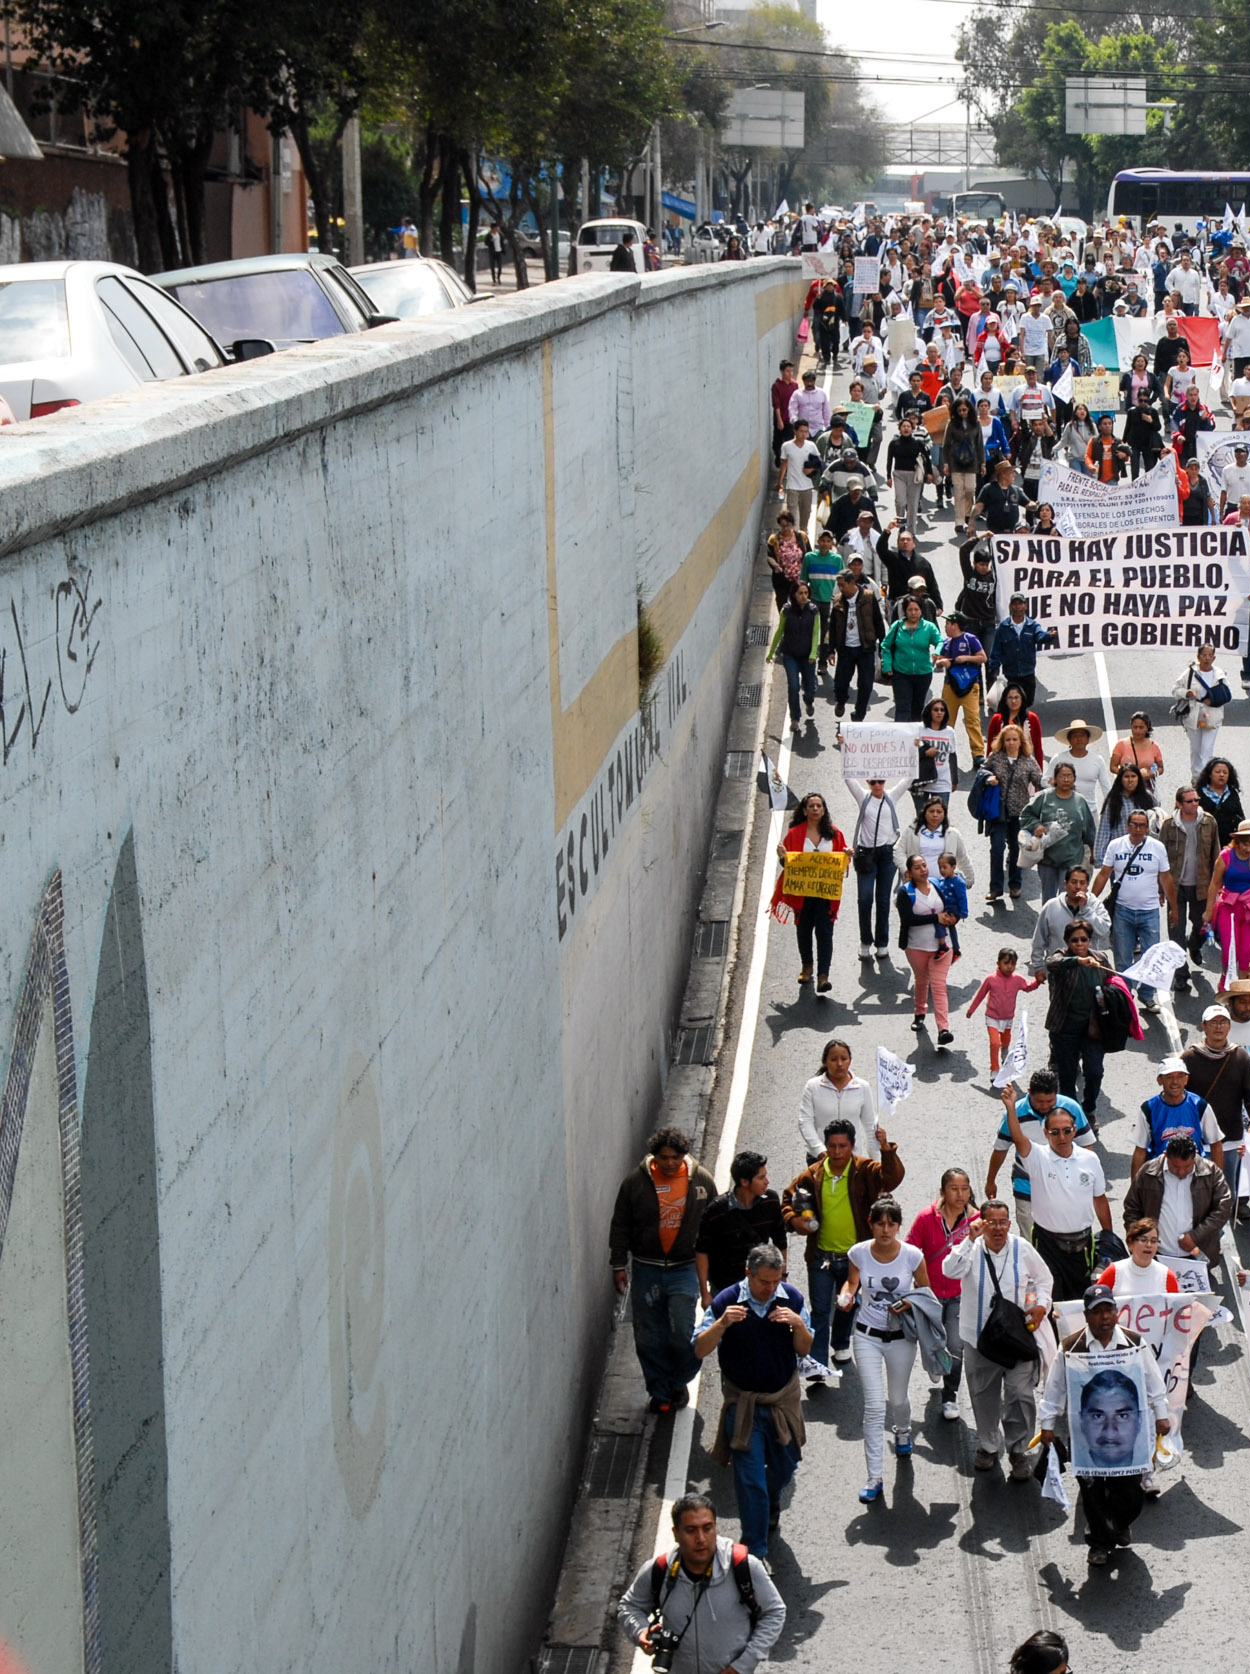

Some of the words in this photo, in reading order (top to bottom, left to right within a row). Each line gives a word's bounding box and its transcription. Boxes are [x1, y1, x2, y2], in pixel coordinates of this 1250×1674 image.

[1057, 482, 1072, 492] PARA
[1067, 472, 1089, 487] FRENTE
[1128, 506, 1165, 517] DERECHOS
[1136, 514, 1176, 524] ELEMENTOS
[997, 540, 1020, 564] SI
[1028, 540, 1060, 564] NO
[1070, 536, 1118, 562] HAY
[1124, 531, 1246, 560] JUSTICIA
[1014, 568, 1080, 592] PARA
[1088, 568, 1112, 588] EL
[1122, 563, 1230, 592] PUEBLO,
[1026, 594, 1052, 620] UE
[1060, 592, 1095, 616] NO
[1103, 593, 1170, 618] HAYA
[1178, 596, 1228, 617] PAZ
[1067, 624, 1094, 648] EL
[1101, 622, 1240, 650] GOBIERNO
[846, 725, 863, 740] Por
[870, 729, 897, 740] favor
[844, 744, 857, 754] NO
[860, 741, 897, 754] OLVIDES
[900, 741, 906, 752] A
[844, 757, 858, 768] LOS
